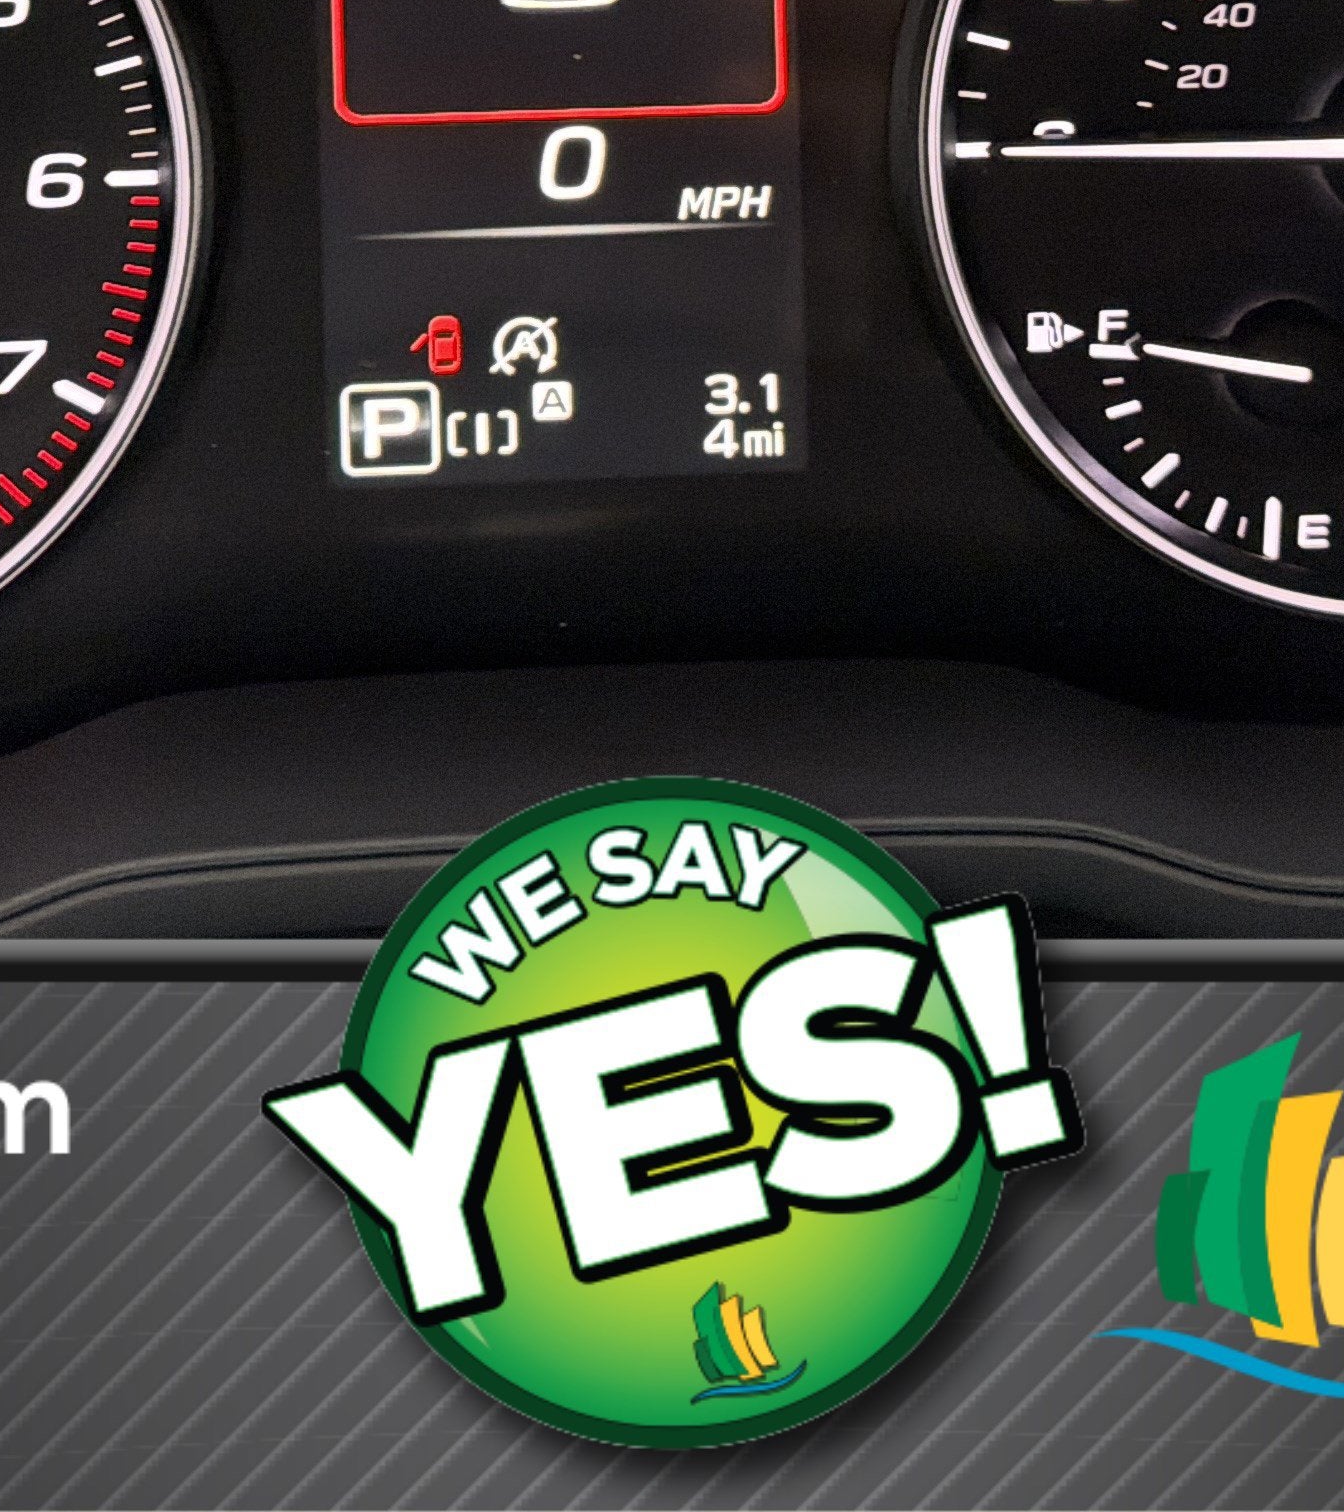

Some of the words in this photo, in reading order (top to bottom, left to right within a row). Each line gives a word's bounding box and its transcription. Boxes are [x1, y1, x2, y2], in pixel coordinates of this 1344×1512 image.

[1202, 1, 1257, 29] 40
[1175, 62, 1230, 90] 20
[25, 151, 89, 210] 6
[538, 124, 608, 202] 0
[675, 183, 774, 222] MPH
[1097, 309, 1129, 343] F
[536, 384, 570, 417] A
[703, 371, 780, 417] 3.1
[362, 397, 421, 460] P
[701, 416, 786, 460] 4mi
[1296, 513, 1333, 551] E
